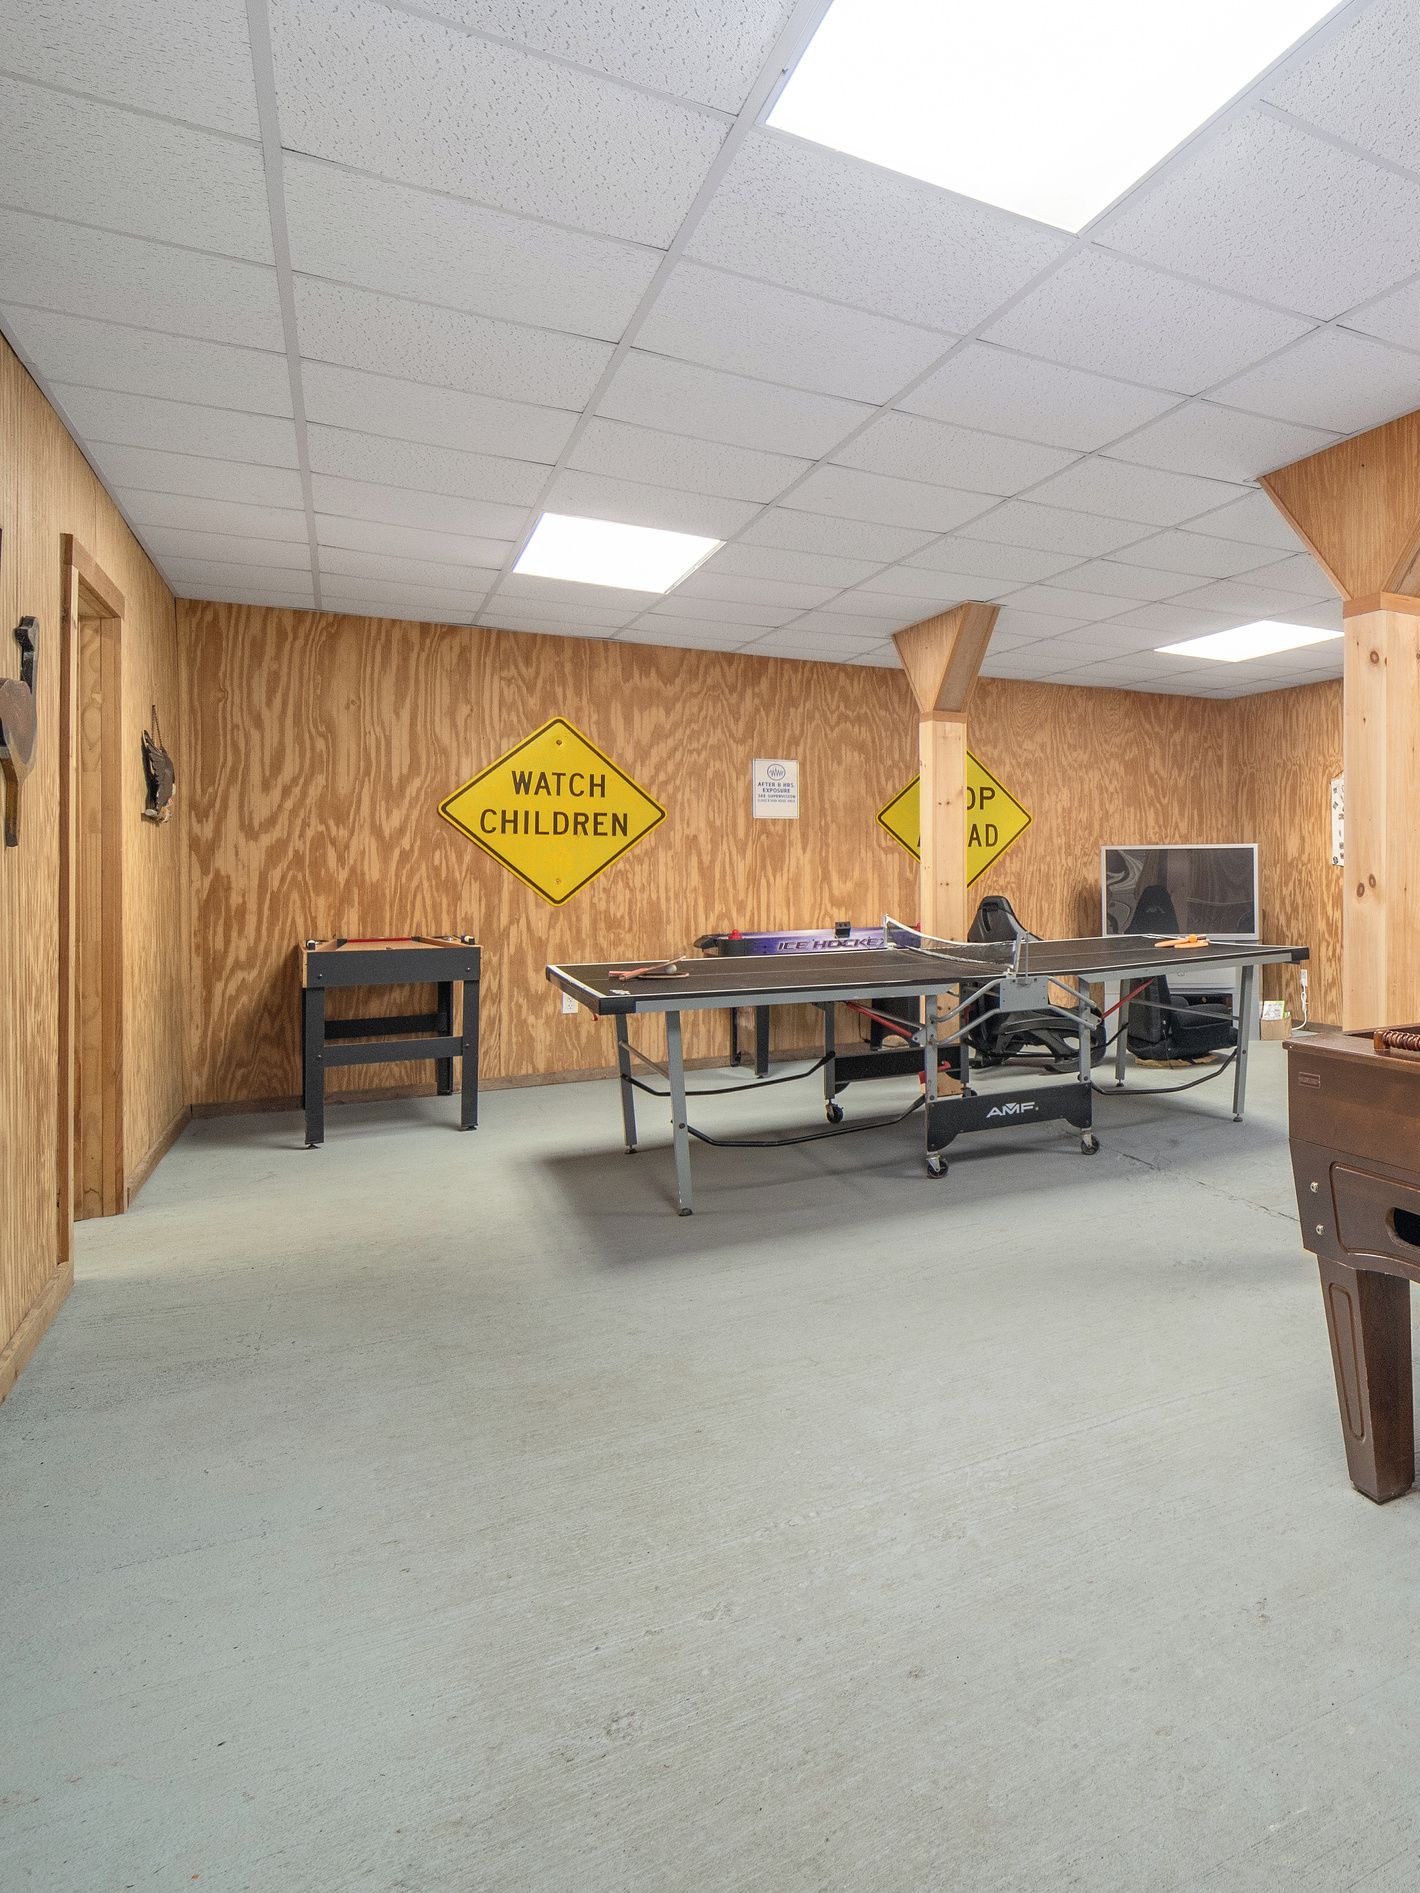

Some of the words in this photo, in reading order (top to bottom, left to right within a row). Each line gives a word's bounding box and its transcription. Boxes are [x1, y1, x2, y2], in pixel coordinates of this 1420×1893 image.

[511, 770, 605, 798] WATCH
[480, 808, 628, 837] CHILDREN
[778, 942, 807, 951] ICE
[986, 1102, 1035, 1119] AMF
